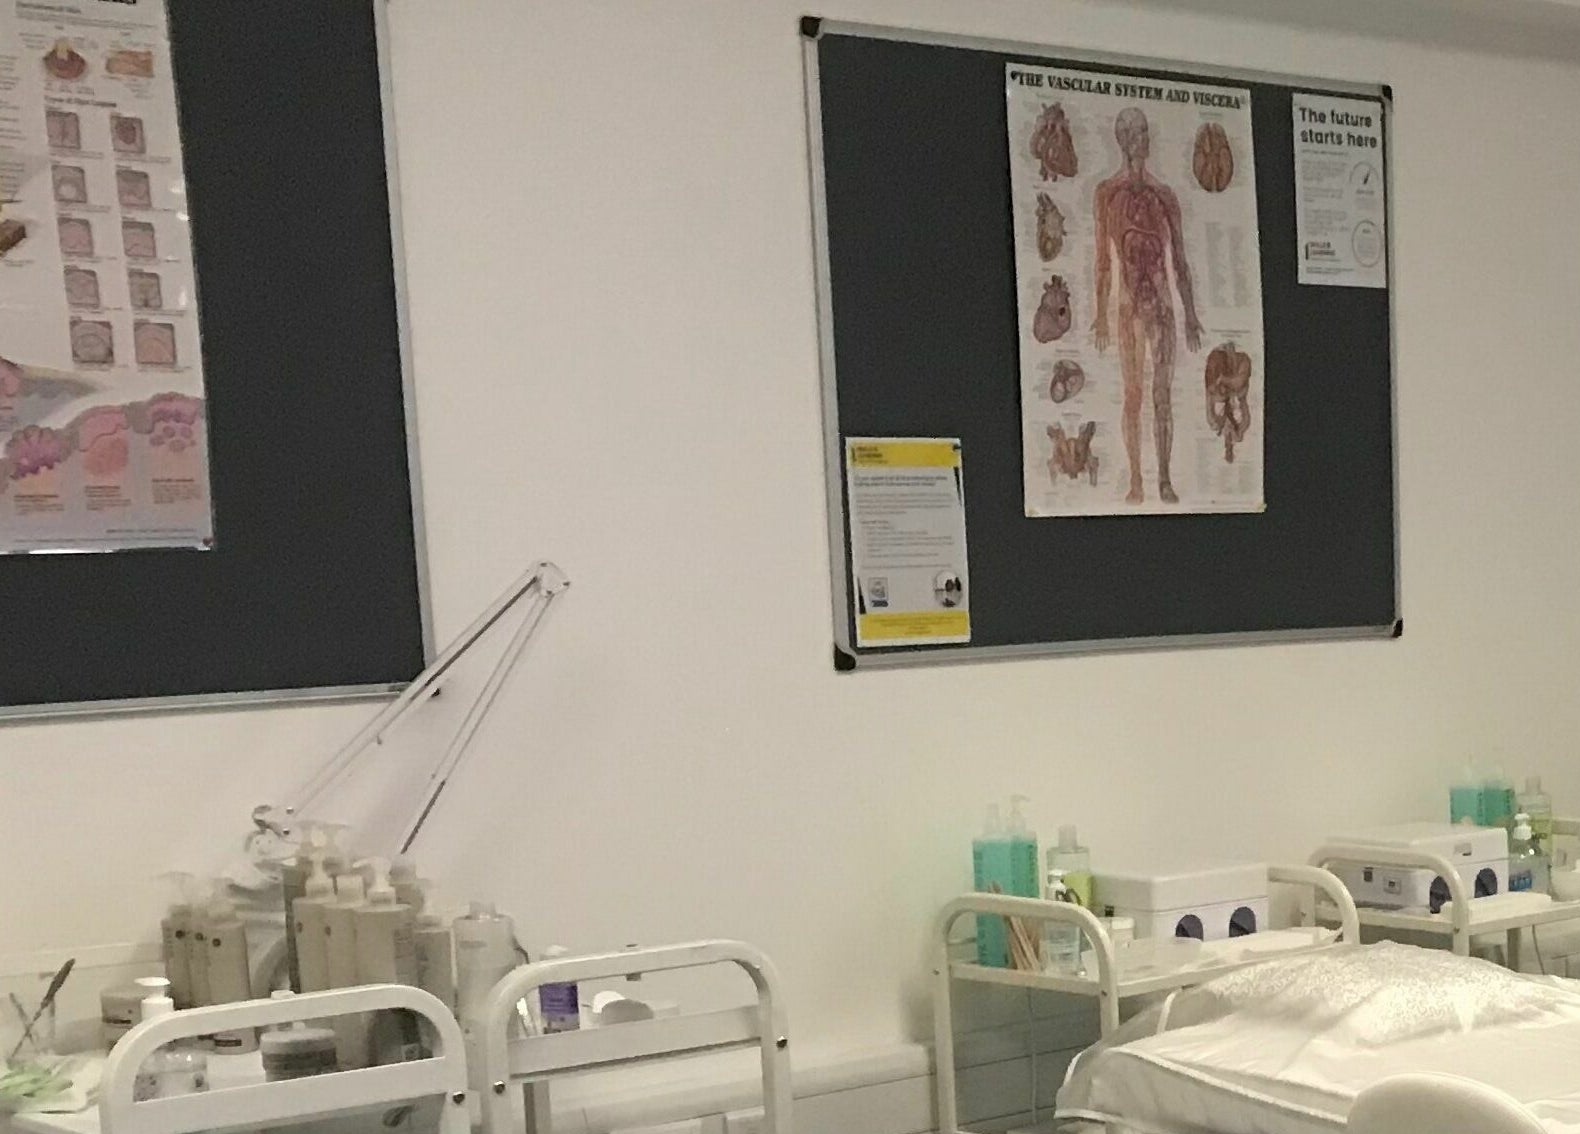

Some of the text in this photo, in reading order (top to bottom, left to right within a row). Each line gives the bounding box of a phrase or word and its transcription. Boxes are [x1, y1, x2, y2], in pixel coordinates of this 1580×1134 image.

[1018, 72, 1241, 109] THE VASCULAR SYSTEM AND VISCERA
[1299, 107, 1372, 128] The future
[1300, 128, 1377, 148] starts here
